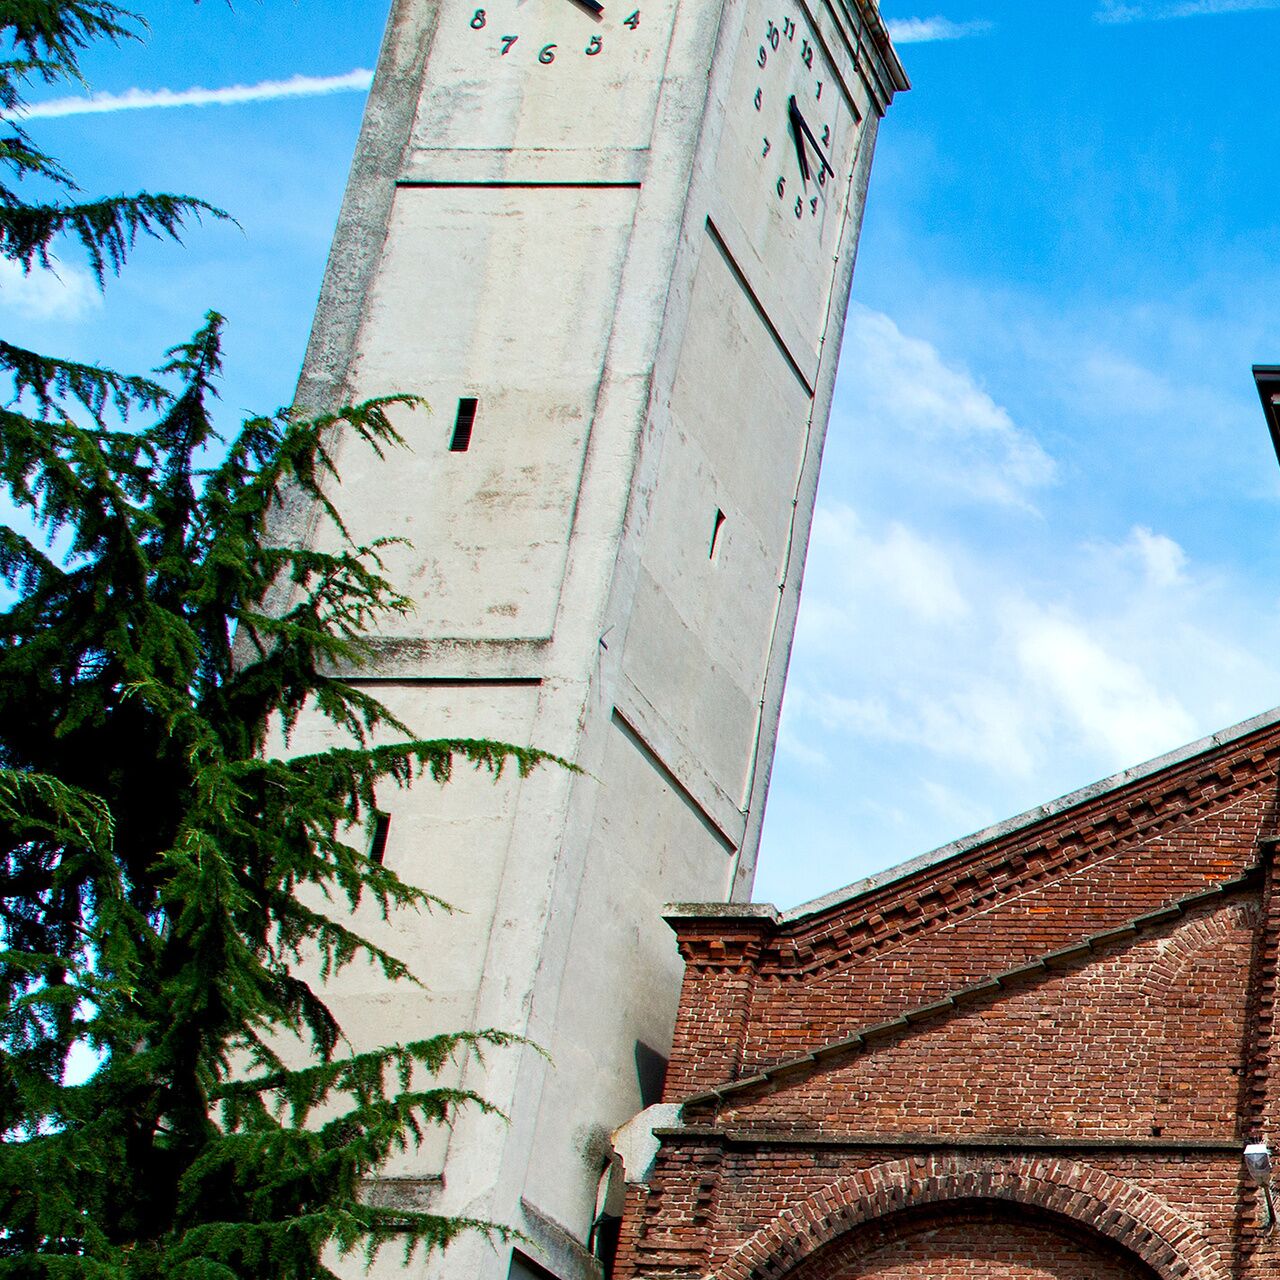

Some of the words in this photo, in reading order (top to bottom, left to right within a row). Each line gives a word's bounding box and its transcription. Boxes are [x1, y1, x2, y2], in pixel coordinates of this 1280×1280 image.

[470, 9, 486, 30] 8
[623, 9, 640, 30] 4
[783, 16, 795, 41] 11
[500, 35, 519, 56] 7
[584, 34, 603, 56] 5
[766, 19, 779, 51] 10
[537, 43, 558, 65] 6
[757, 46, 767, 69] 9
[801, 39, 813, 71] 12
[754, 87, 762, 111] 8
[816, 80, 823, 102] 1
[762, 137, 771, 157] 7
[821, 124, 830, 148] 2
[777, 176, 786, 199] 6
[795, 196, 803, 219] 5
[810, 197, 818, 216] 4
